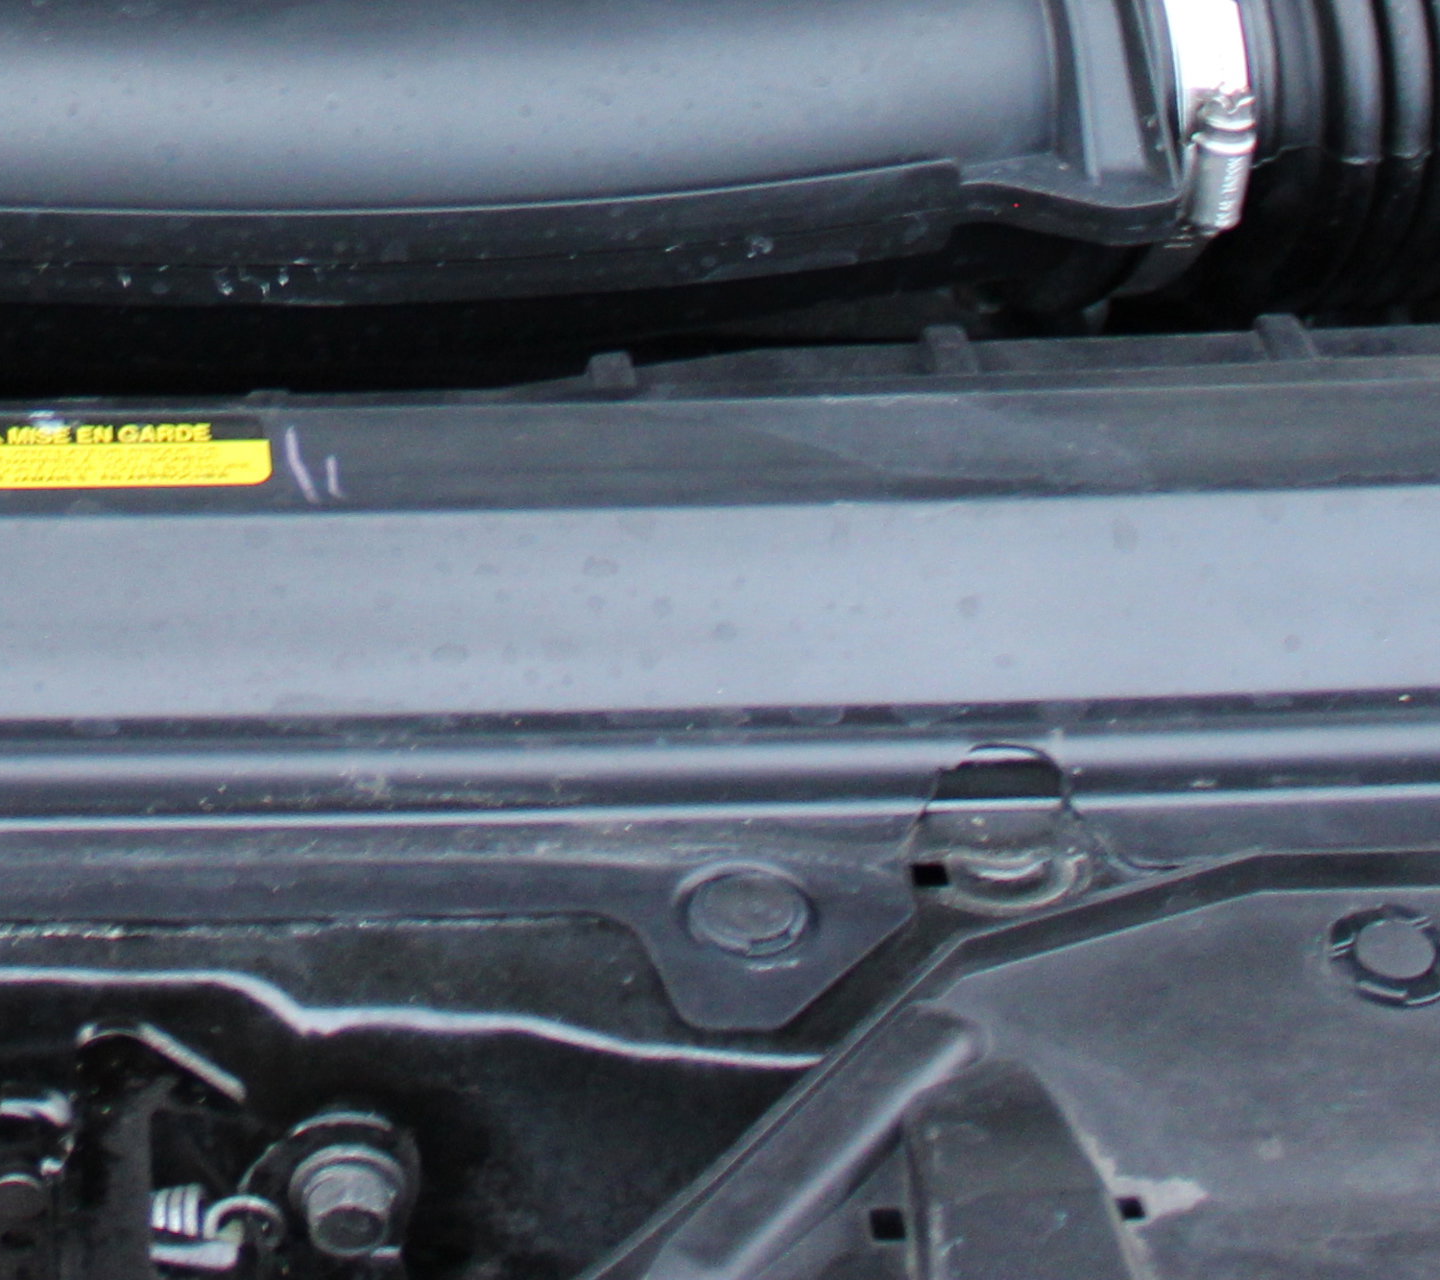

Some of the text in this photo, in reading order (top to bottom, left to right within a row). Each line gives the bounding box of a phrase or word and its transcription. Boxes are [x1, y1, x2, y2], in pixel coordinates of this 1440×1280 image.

[6, 422, 213, 445] MISE EN GARDE
